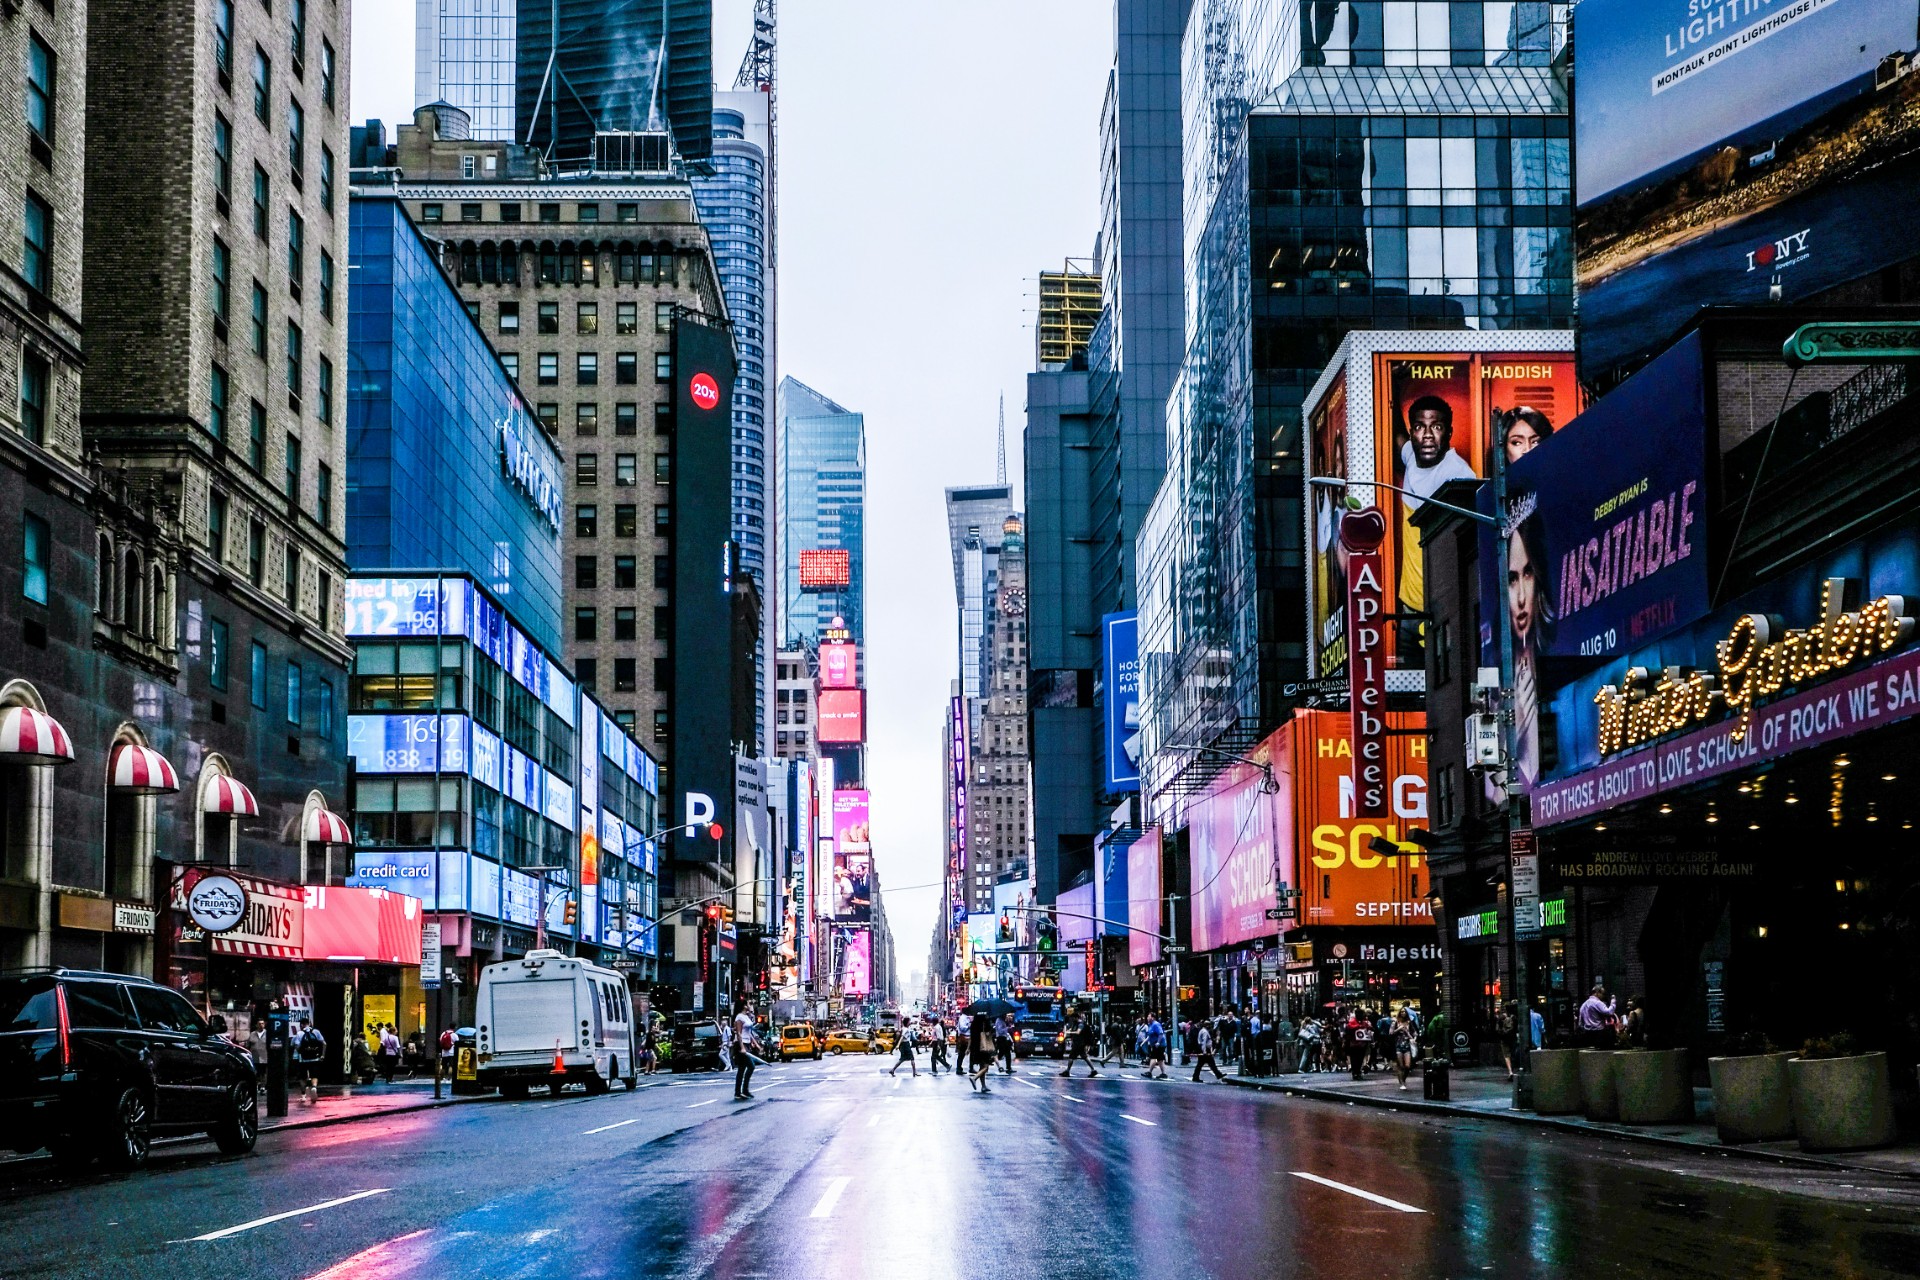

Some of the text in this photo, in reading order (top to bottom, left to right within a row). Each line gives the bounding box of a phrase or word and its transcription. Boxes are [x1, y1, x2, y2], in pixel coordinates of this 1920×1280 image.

[1657, 3, 1811, 89] MONTAUK POINT LIGHTHOUSE
[1746, 228, 1811, 272] I NY
[1411, 365, 1553, 379] HART HADDISH
[693, 382, 717, 400] 20x
[1594, 477, 1649, 522] DEBBY RYAN IS
[1558, 479, 1698, 621] INSATIABLE
[826, 630, 850, 639] 2018
[1323, 605, 1344, 649] NIGHT
[1580, 595, 1676, 656] AUG 10 NETFLIX
[1320, 634, 1348, 679] SCHOOL
[1715, 578, 1910, 744] Garden
[1594, 667, 1714, 755] Winter
[402, 718, 460, 743] 1692
[953, 697, 963, 782] LADY
[1540, 667, 1920, 820] FOR THOSE ABOUT TO LOVE SCHOOL OF ROCK, WE SA
[378, 749, 420, 768] 1838
[738, 762, 758, 776] wrinkles
[738, 779, 764, 793] can now be
[685, 792, 714, 838] P
[1233, 777, 1265, 847] NIGHT
[359, 863, 430, 878] credit card
[1559, 863, 1754, 876] HAS BROADWAY ROCKING AGAIN!
[1641, 852, 1673, 863] LLOYD
[1676, 851, 1718, 863] WEBBER
[1230, 839, 1274, 909] SCHOOL
[122, 911, 150, 927] FRIDAY'S
[199, 900, 236, 910] FRIDAY'S
[1545, 899, 1566, 927] COFFEE
[1481, 910, 1499, 936] COFFEE
[274, 1020, 282, 1031] P
